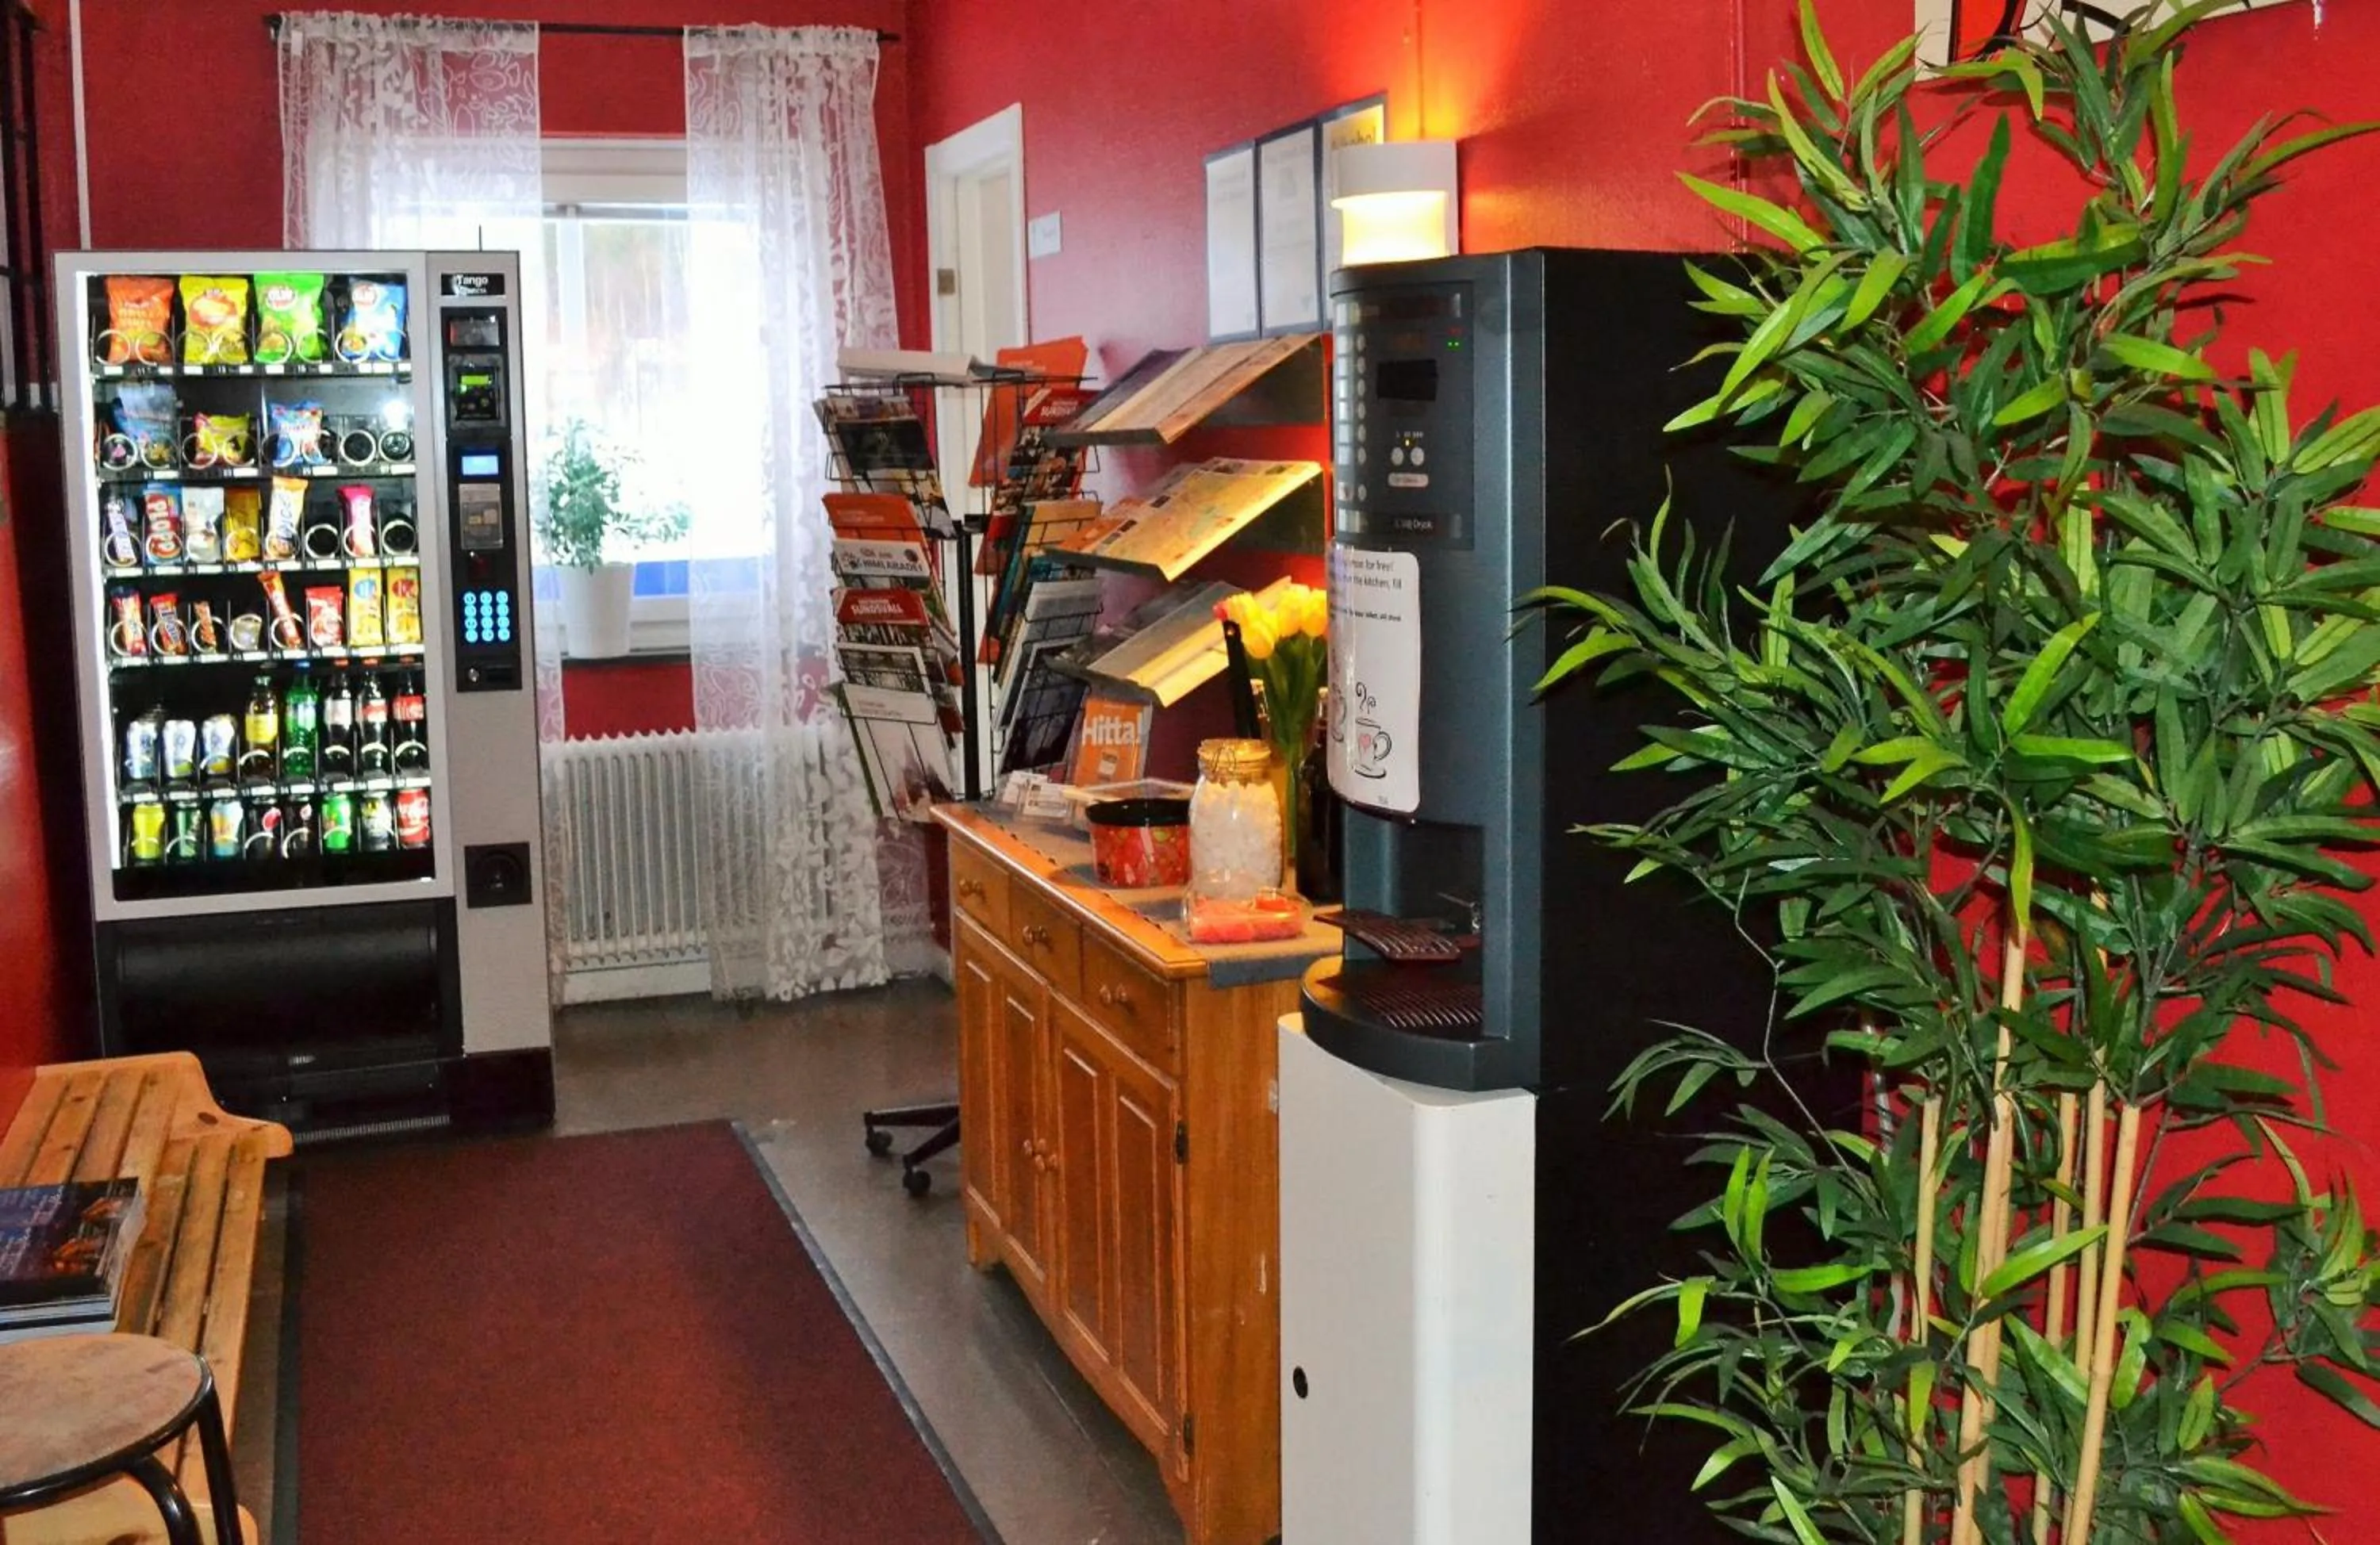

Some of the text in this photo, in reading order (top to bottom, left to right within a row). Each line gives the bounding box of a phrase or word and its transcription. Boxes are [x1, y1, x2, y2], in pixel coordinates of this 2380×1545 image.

[456, 274, 489, 287] Tango
[147, 499, 176, 552] PLOPP
[1081, 711, 1142, 746] Hitta!
